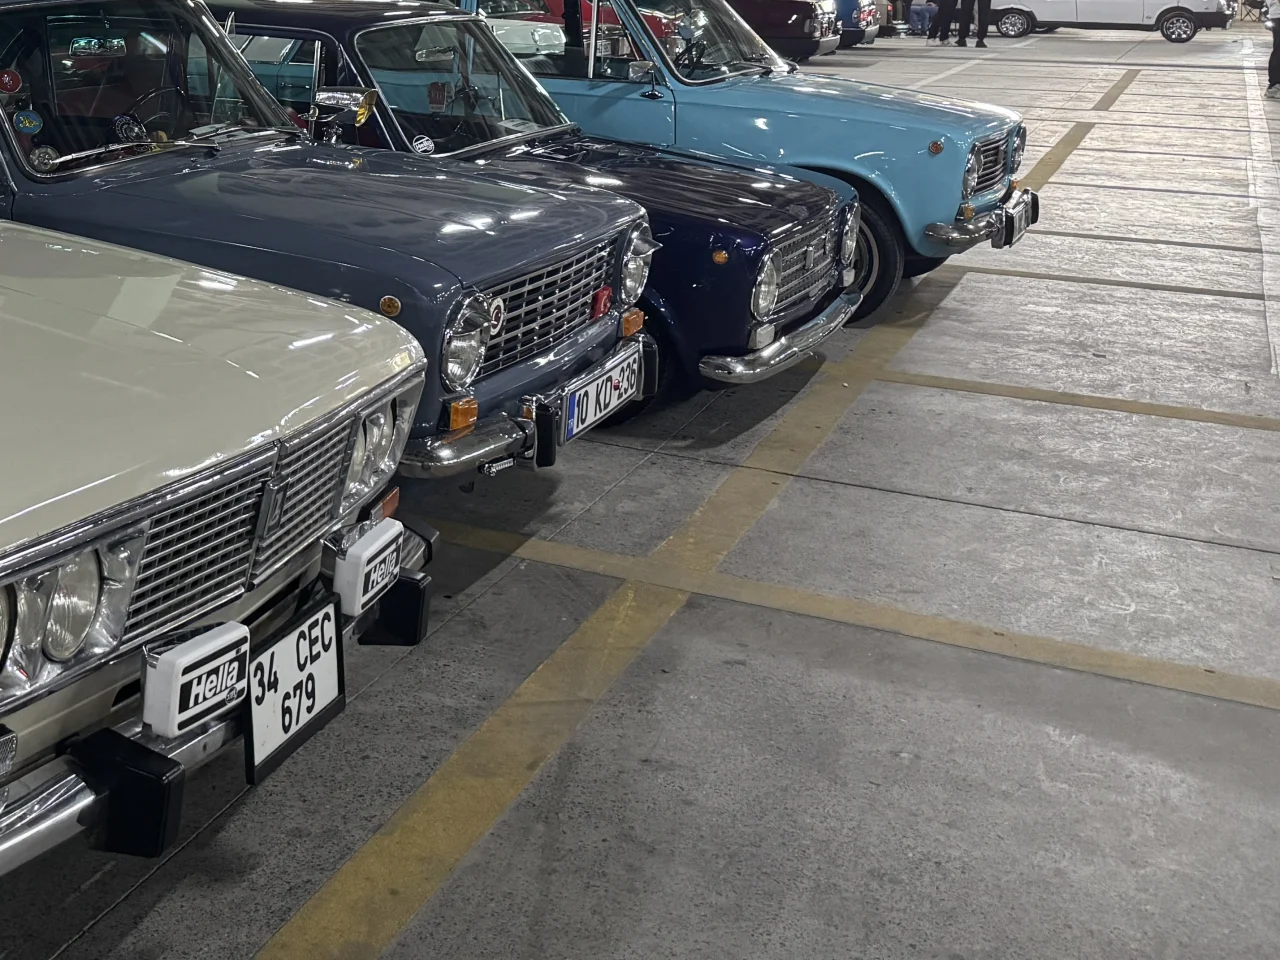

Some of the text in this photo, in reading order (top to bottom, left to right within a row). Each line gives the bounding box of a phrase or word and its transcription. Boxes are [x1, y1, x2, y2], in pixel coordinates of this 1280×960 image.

[576, 357, 637, 429] 10 KD 236
[368, 551, 397, 591] Hella
[188, 660, 240, 709] Hella
[253, 611, 333, 706] 34 CEC
[280, 672, 316, 735] 679
